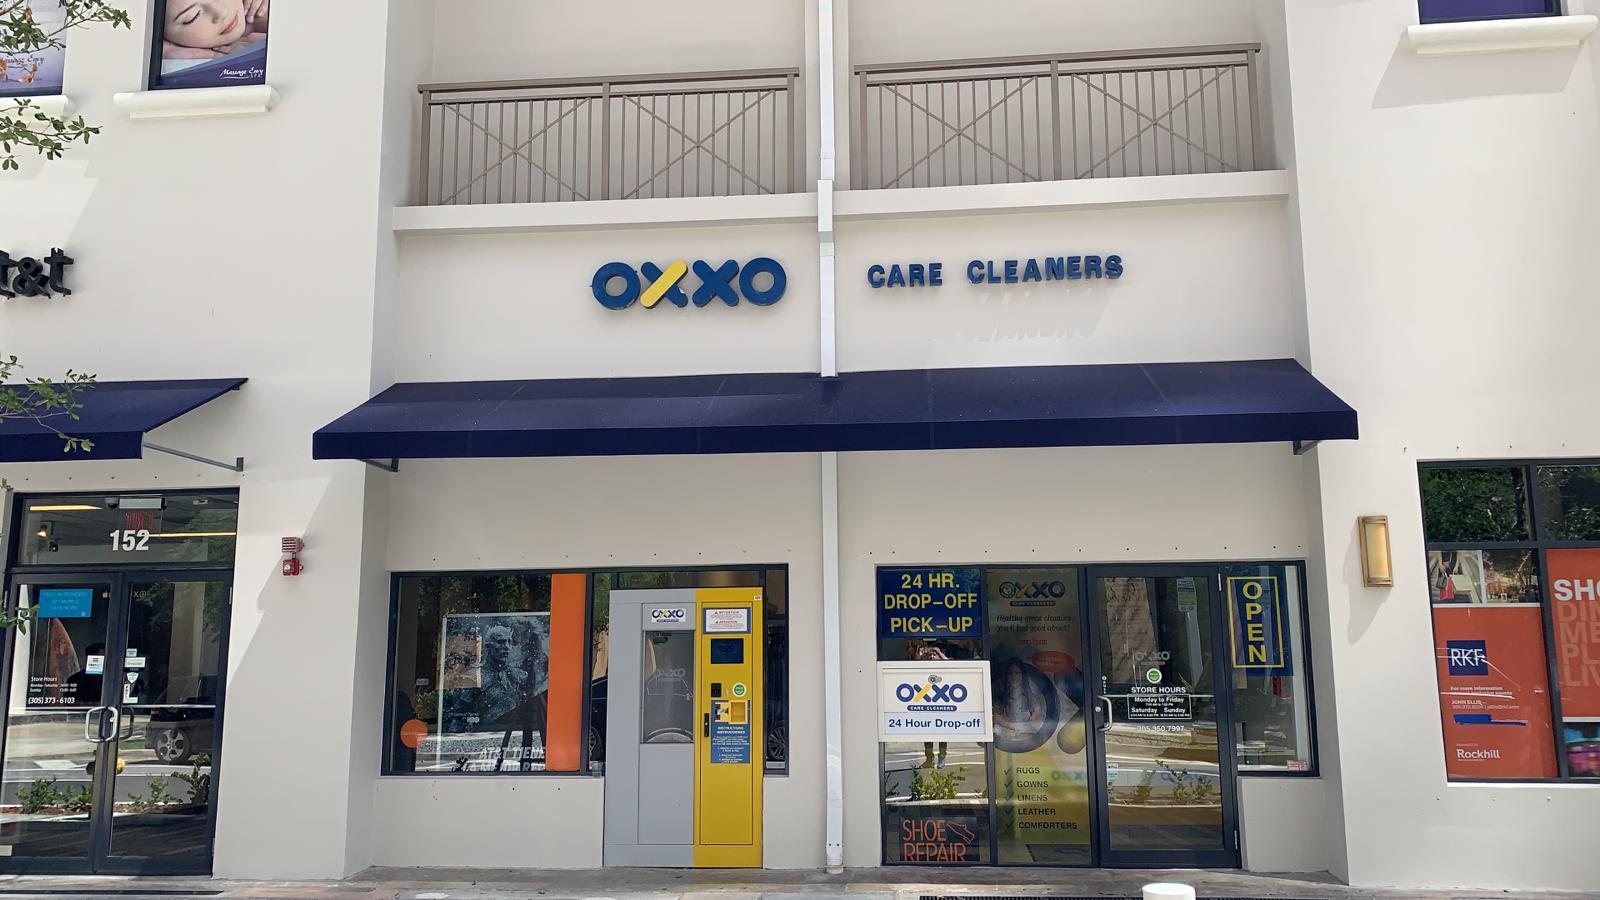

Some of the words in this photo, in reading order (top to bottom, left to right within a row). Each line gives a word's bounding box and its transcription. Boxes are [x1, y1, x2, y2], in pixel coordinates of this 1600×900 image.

[868, 263, 942, 289] CARE
[967, 254, 1124, 285] CLEANERS
[590, 257, 787, 310] OXXO
[110, 529, 151, 551] 152
[901, 573, 923, 589] 24
[928, 572, 960, 589] HR.
[999, 580, 1066, 599] OXXO
[1553, 579, 1600, 601] SH
[884, 592, 978, 610] DROP-OFF
[651, 609, 685, 619] OXXO
[1242, 581, 1267, 663] OPEN
[890, 616, 973, 633] PICK-UP
[1450, 648, 1483, 667] RKF
[28, 696, 44, 704] (305)
[896, 683, 968, 704] OXXO
[888, 718, 902, 728] 24
[905, 718, 932, 728] Hour
[935, 718, 981, 730] Drop-off
[1456, 748, 1501, 759] Rockhill
[1016, 767, 1041, 775] RUGS
[1016, 780, 1049, 789] GOWNS
[1017, 794, 1048, 802] LINENS
[1017, 808, 1056, 816] LEATHER
[902, 819, 947, 843] SHOE
[1018, 821, 1078, 830] COMFORTERS
[903, 842, 967, 862] REPAIR
